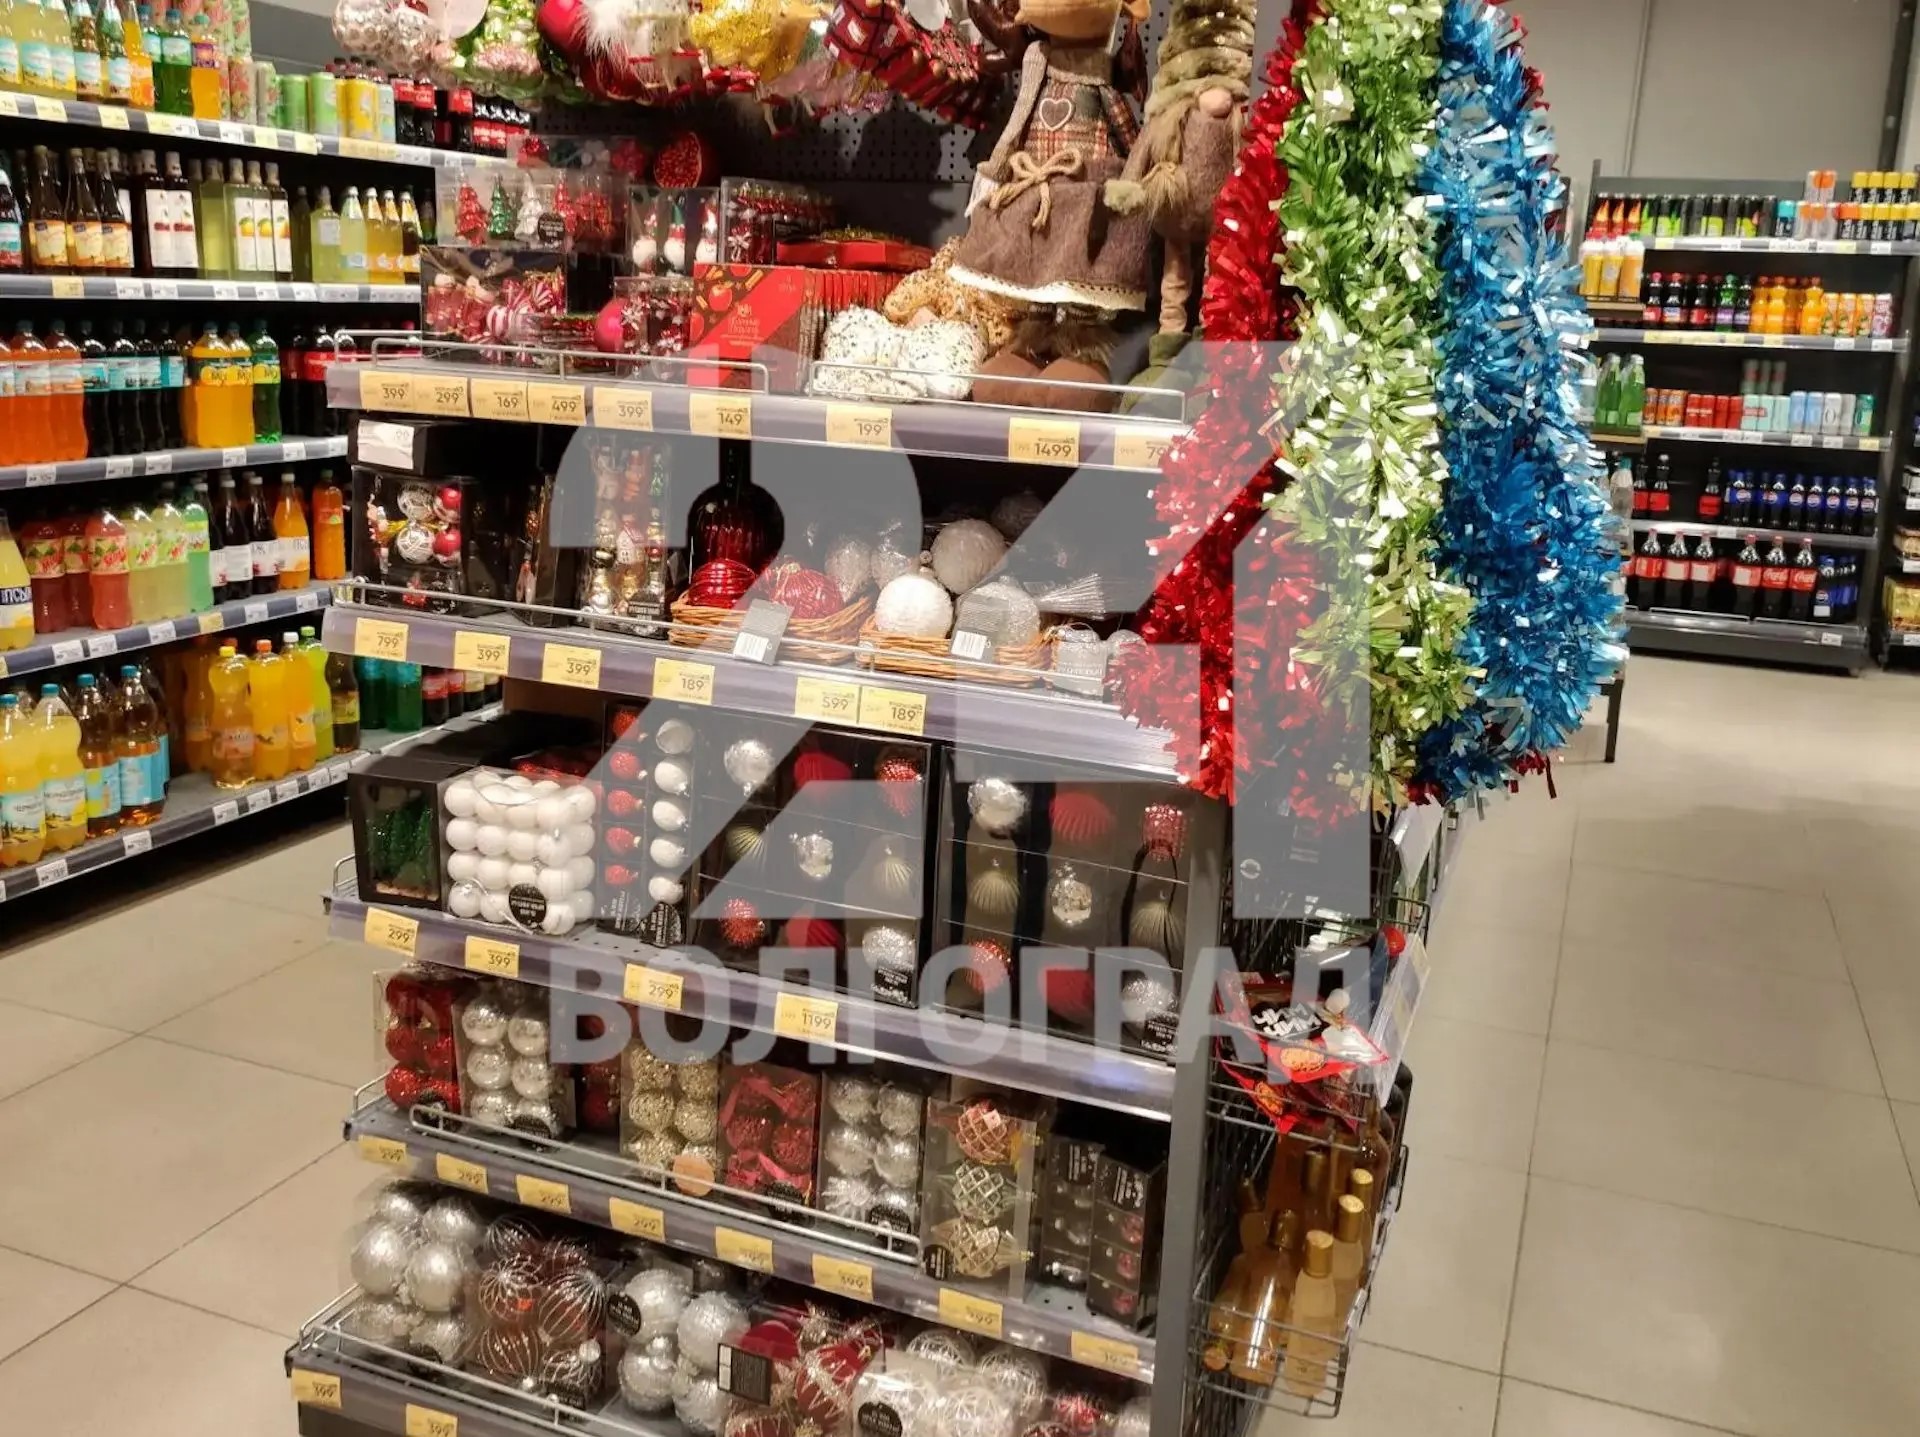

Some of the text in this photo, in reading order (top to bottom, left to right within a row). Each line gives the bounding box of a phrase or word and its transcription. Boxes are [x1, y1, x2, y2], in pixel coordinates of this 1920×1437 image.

[383, 387, 406, 399] 399
[436, 392, 460, 403] 299
[497, 396, 518, 408] 169
[552, 400, 577, 412] 499
[618, 406, 643, 418] 399
[719, 413, 742, 425] 149
[858, 423, 882, 436] 199
[1034, 442, 1072, 457] 1499
[1146, 446, 1167, 459] 79
[377, 636, 399, 649] 799
[477, 649, 501, 661] 399
[567, 663, 590, 676] 399
[682, 678, 704, 692] 189
[823, 696, 848, 711] 599
[891, 707, 916, 722] 189
[388, 929, 410, 943] 299
[488, 954, 511, 969] 399
[649, 983, 674, 999] 299
[802, 1012, 832, 1029] 1199
